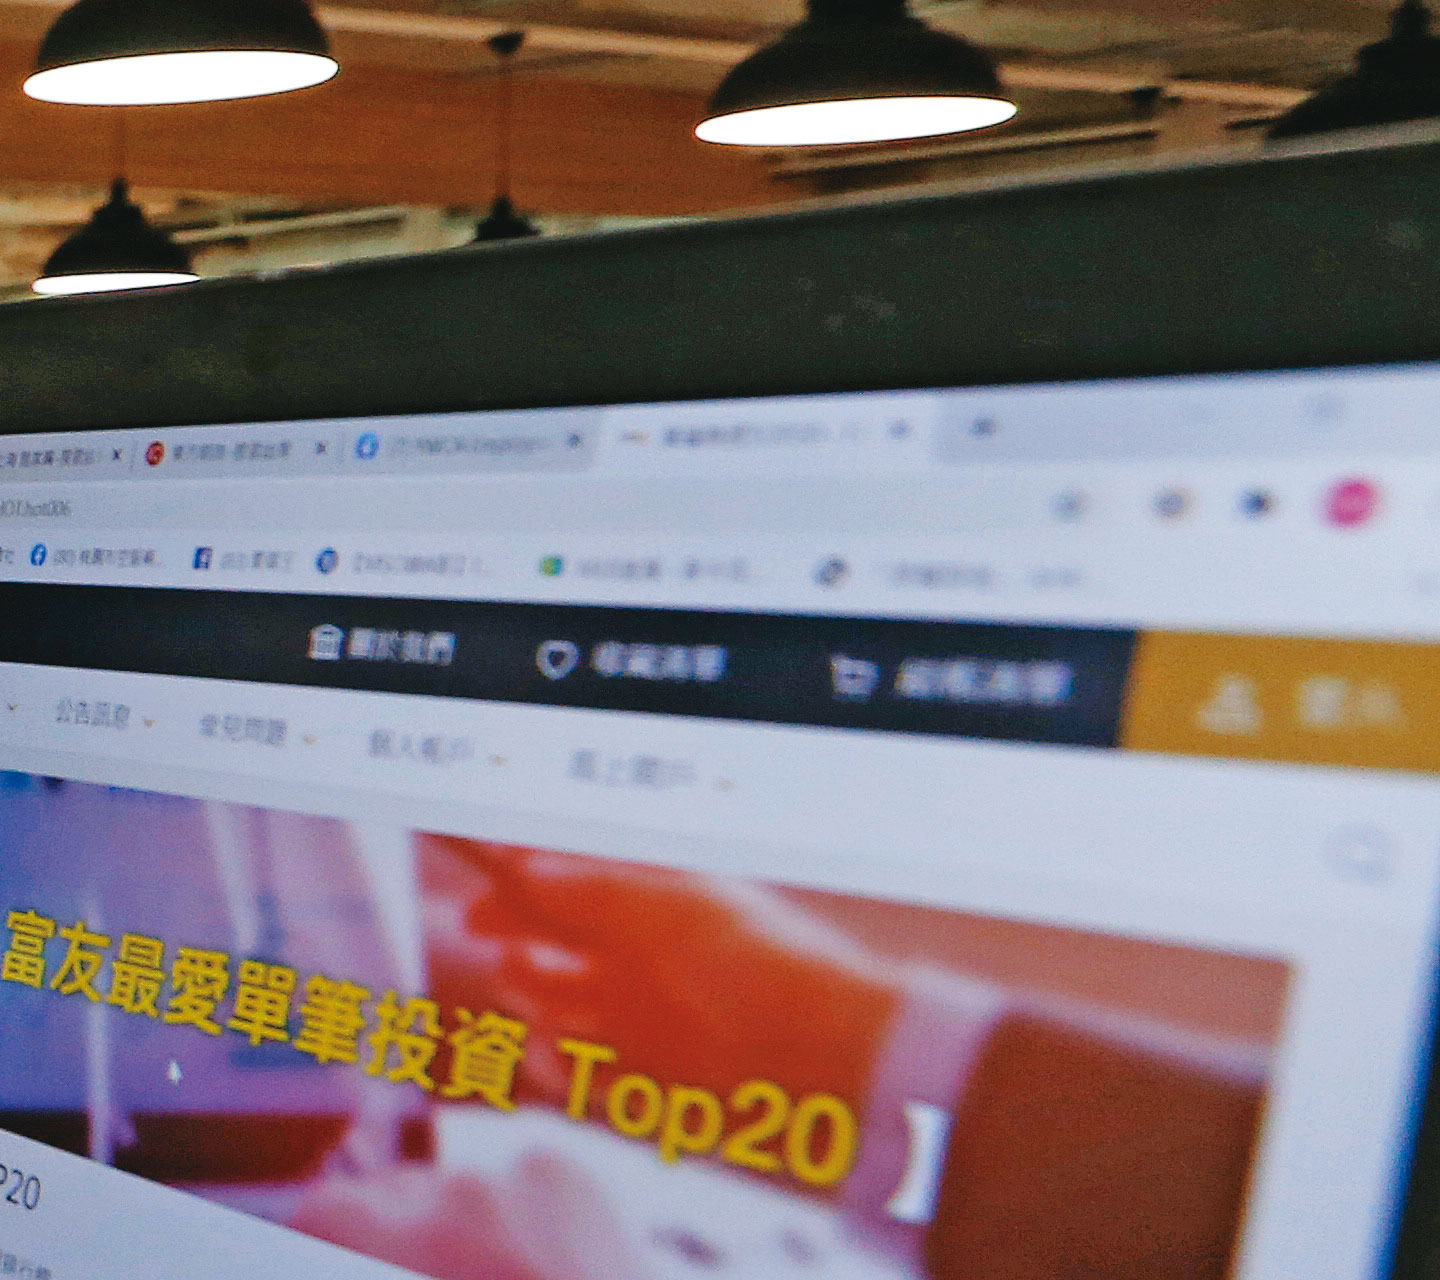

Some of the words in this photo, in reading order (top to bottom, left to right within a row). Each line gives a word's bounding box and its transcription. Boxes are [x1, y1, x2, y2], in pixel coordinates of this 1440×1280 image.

[0, 909, 529, 1112] 富友最愛單筆投資
[557, 1036, 859, 1188] Top20
